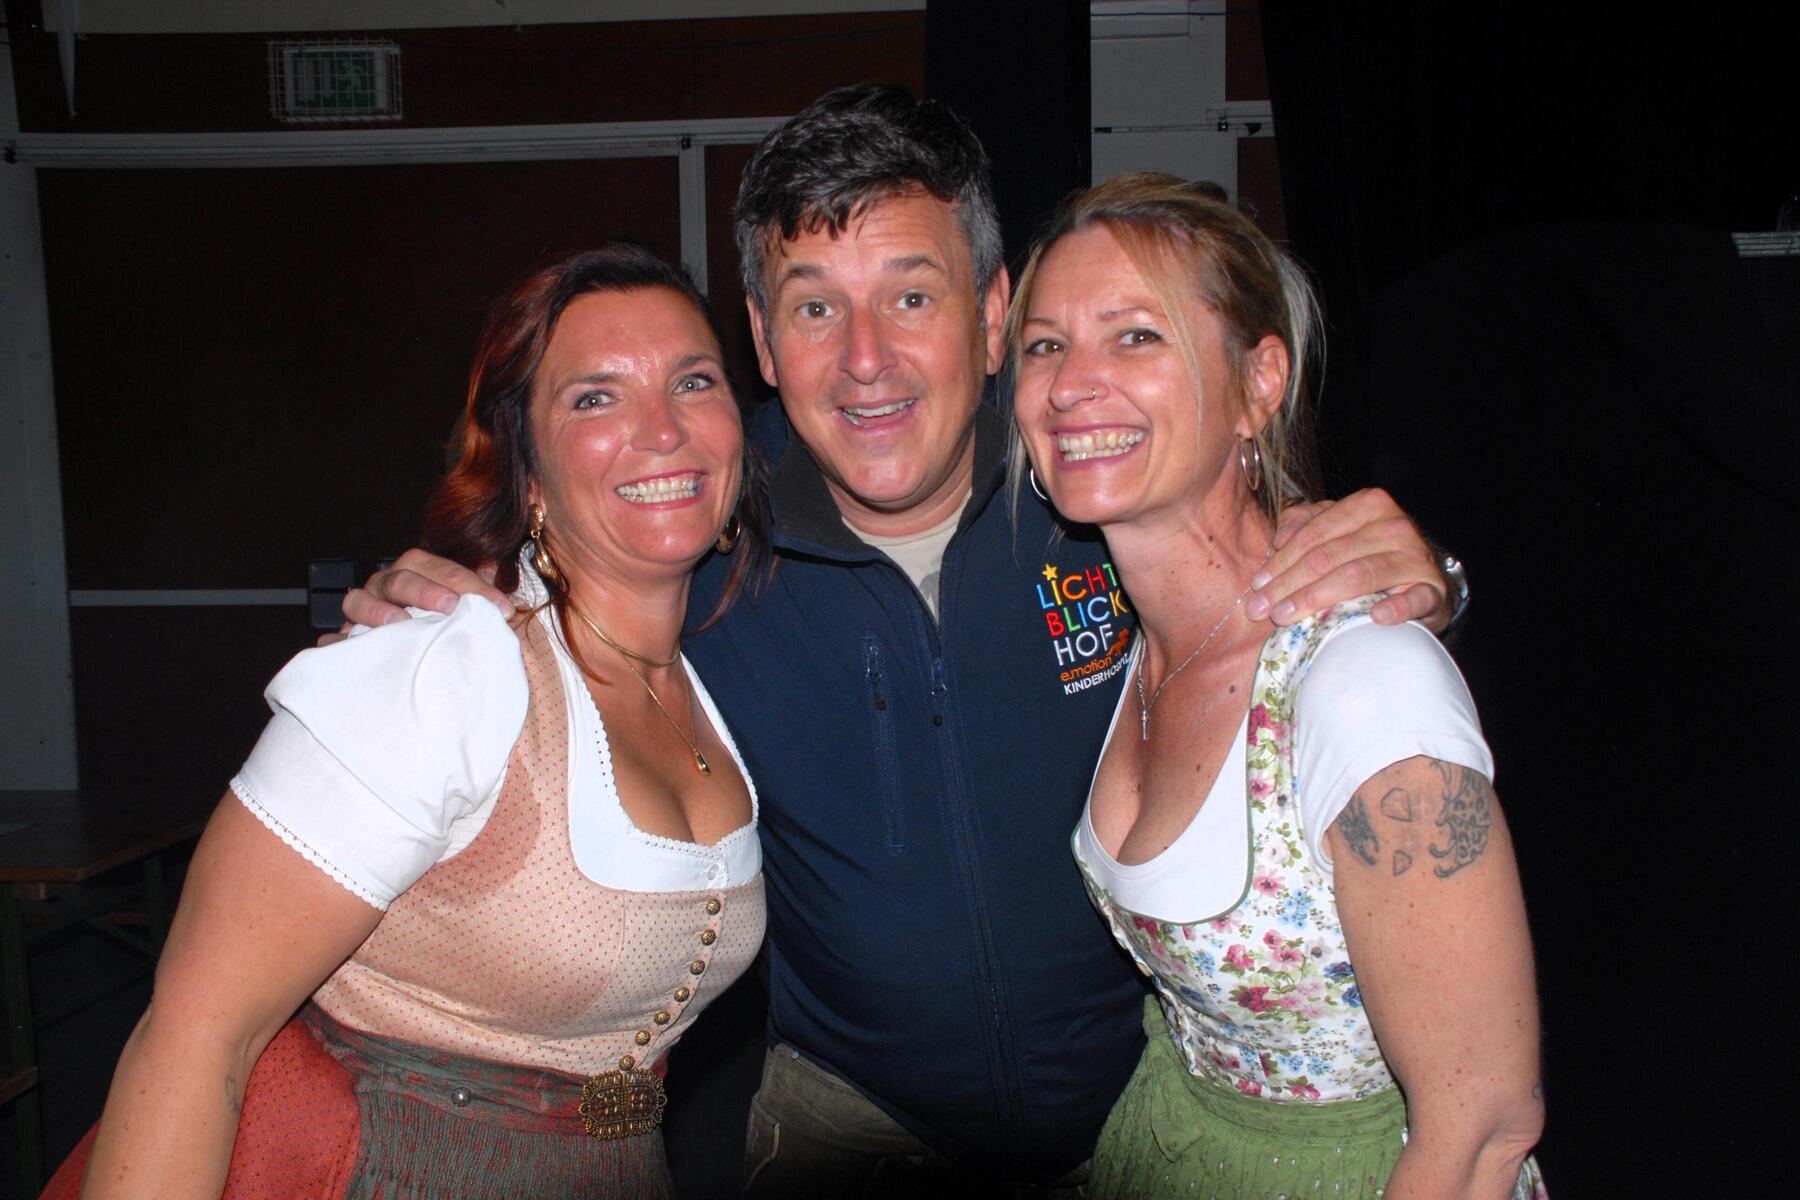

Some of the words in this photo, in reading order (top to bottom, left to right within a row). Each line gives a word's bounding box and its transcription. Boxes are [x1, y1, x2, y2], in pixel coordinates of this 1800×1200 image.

[1045, 590, 1129, 637] BLICK
[1054, 623, 1114, 666] HOF
[1060, 656, 1113, 682] e.motion
